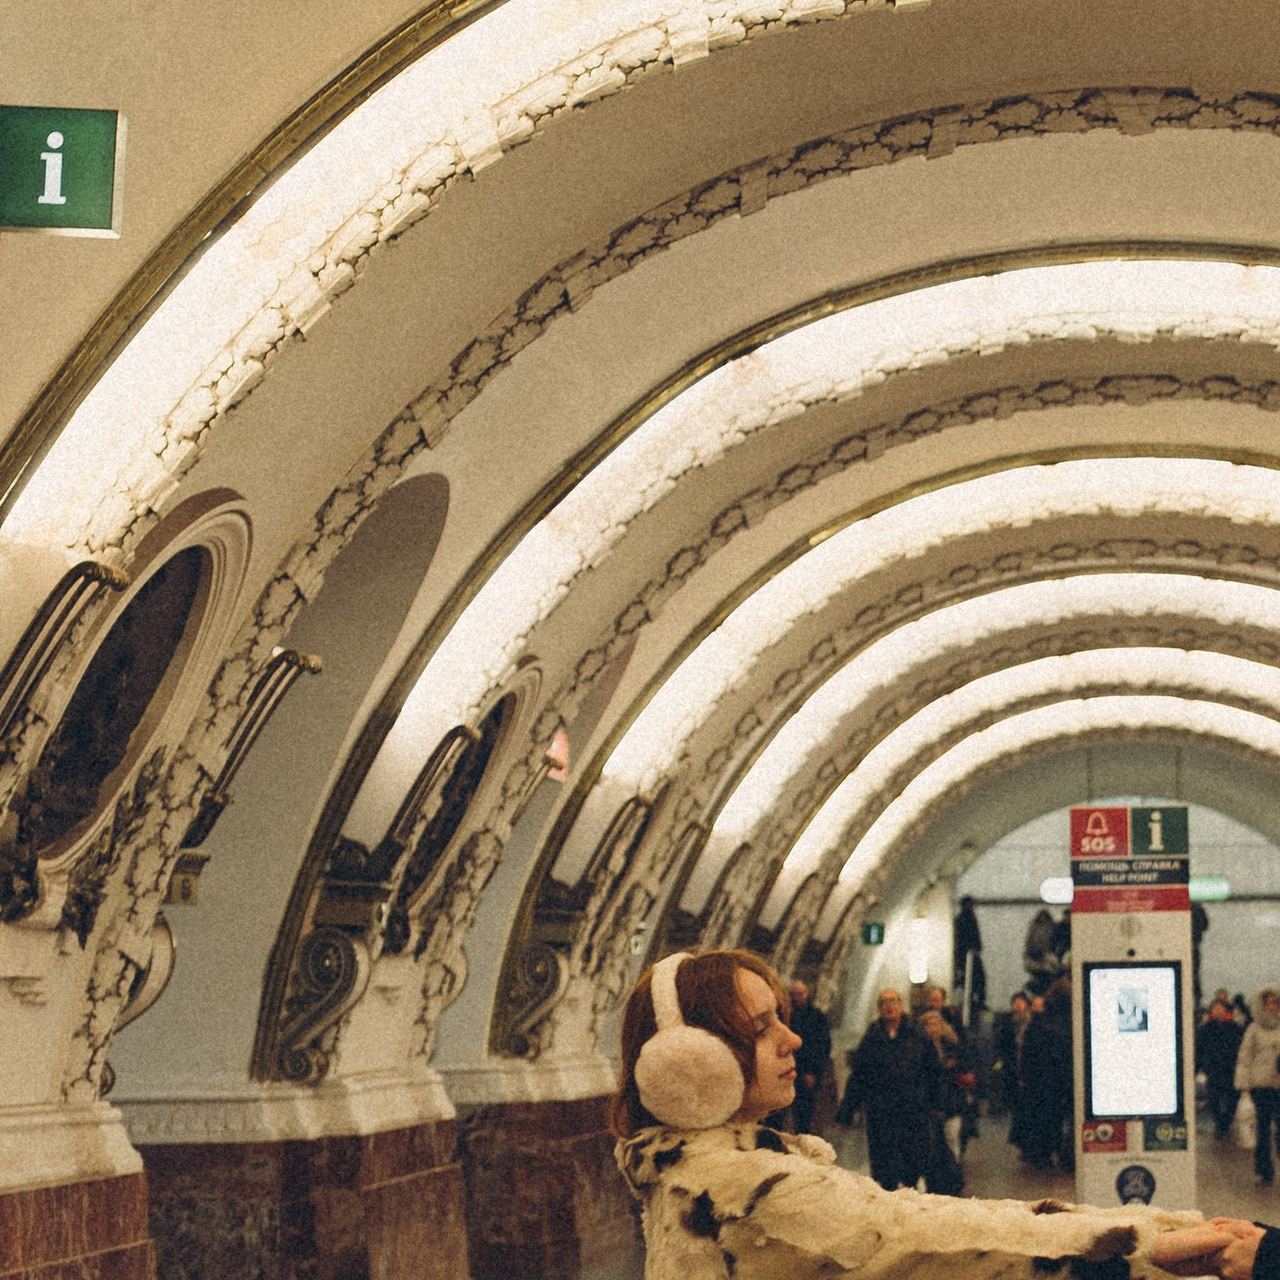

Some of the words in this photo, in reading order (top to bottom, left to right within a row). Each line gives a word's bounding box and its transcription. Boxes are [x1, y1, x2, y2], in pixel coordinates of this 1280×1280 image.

[37, 131, 67, 205] i
[1147, 810, 1165, 851] i
[1080, 836, 1117, 853] SOS
[1079, 861, 1130, 872] ПОМОЩЬ
[1132, 860, 1181, 871] СПРАВКА
[1101, 873, 1126, 883] HELP
[1127, 872, 1159, 882] POINT
